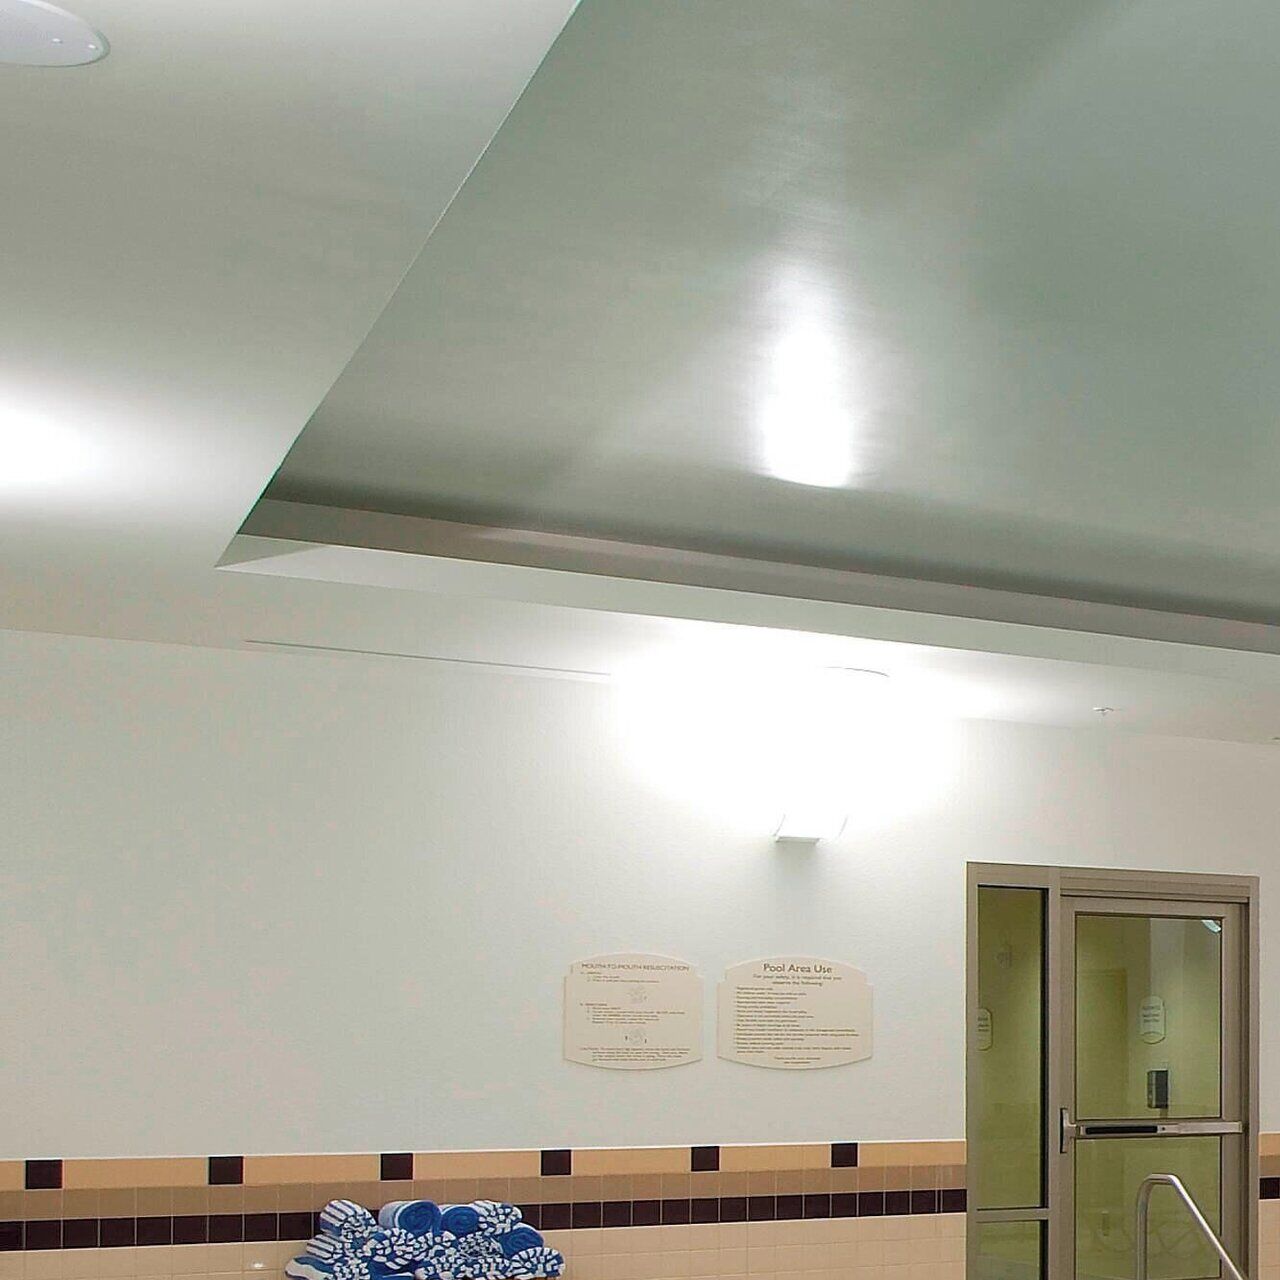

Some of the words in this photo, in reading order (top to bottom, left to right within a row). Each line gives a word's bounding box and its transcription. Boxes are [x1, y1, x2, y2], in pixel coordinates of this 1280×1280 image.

[763, 963, 785, 972] Pool
[788, 964, 811, 973] Area
[813, 965, 832, 974] Use
